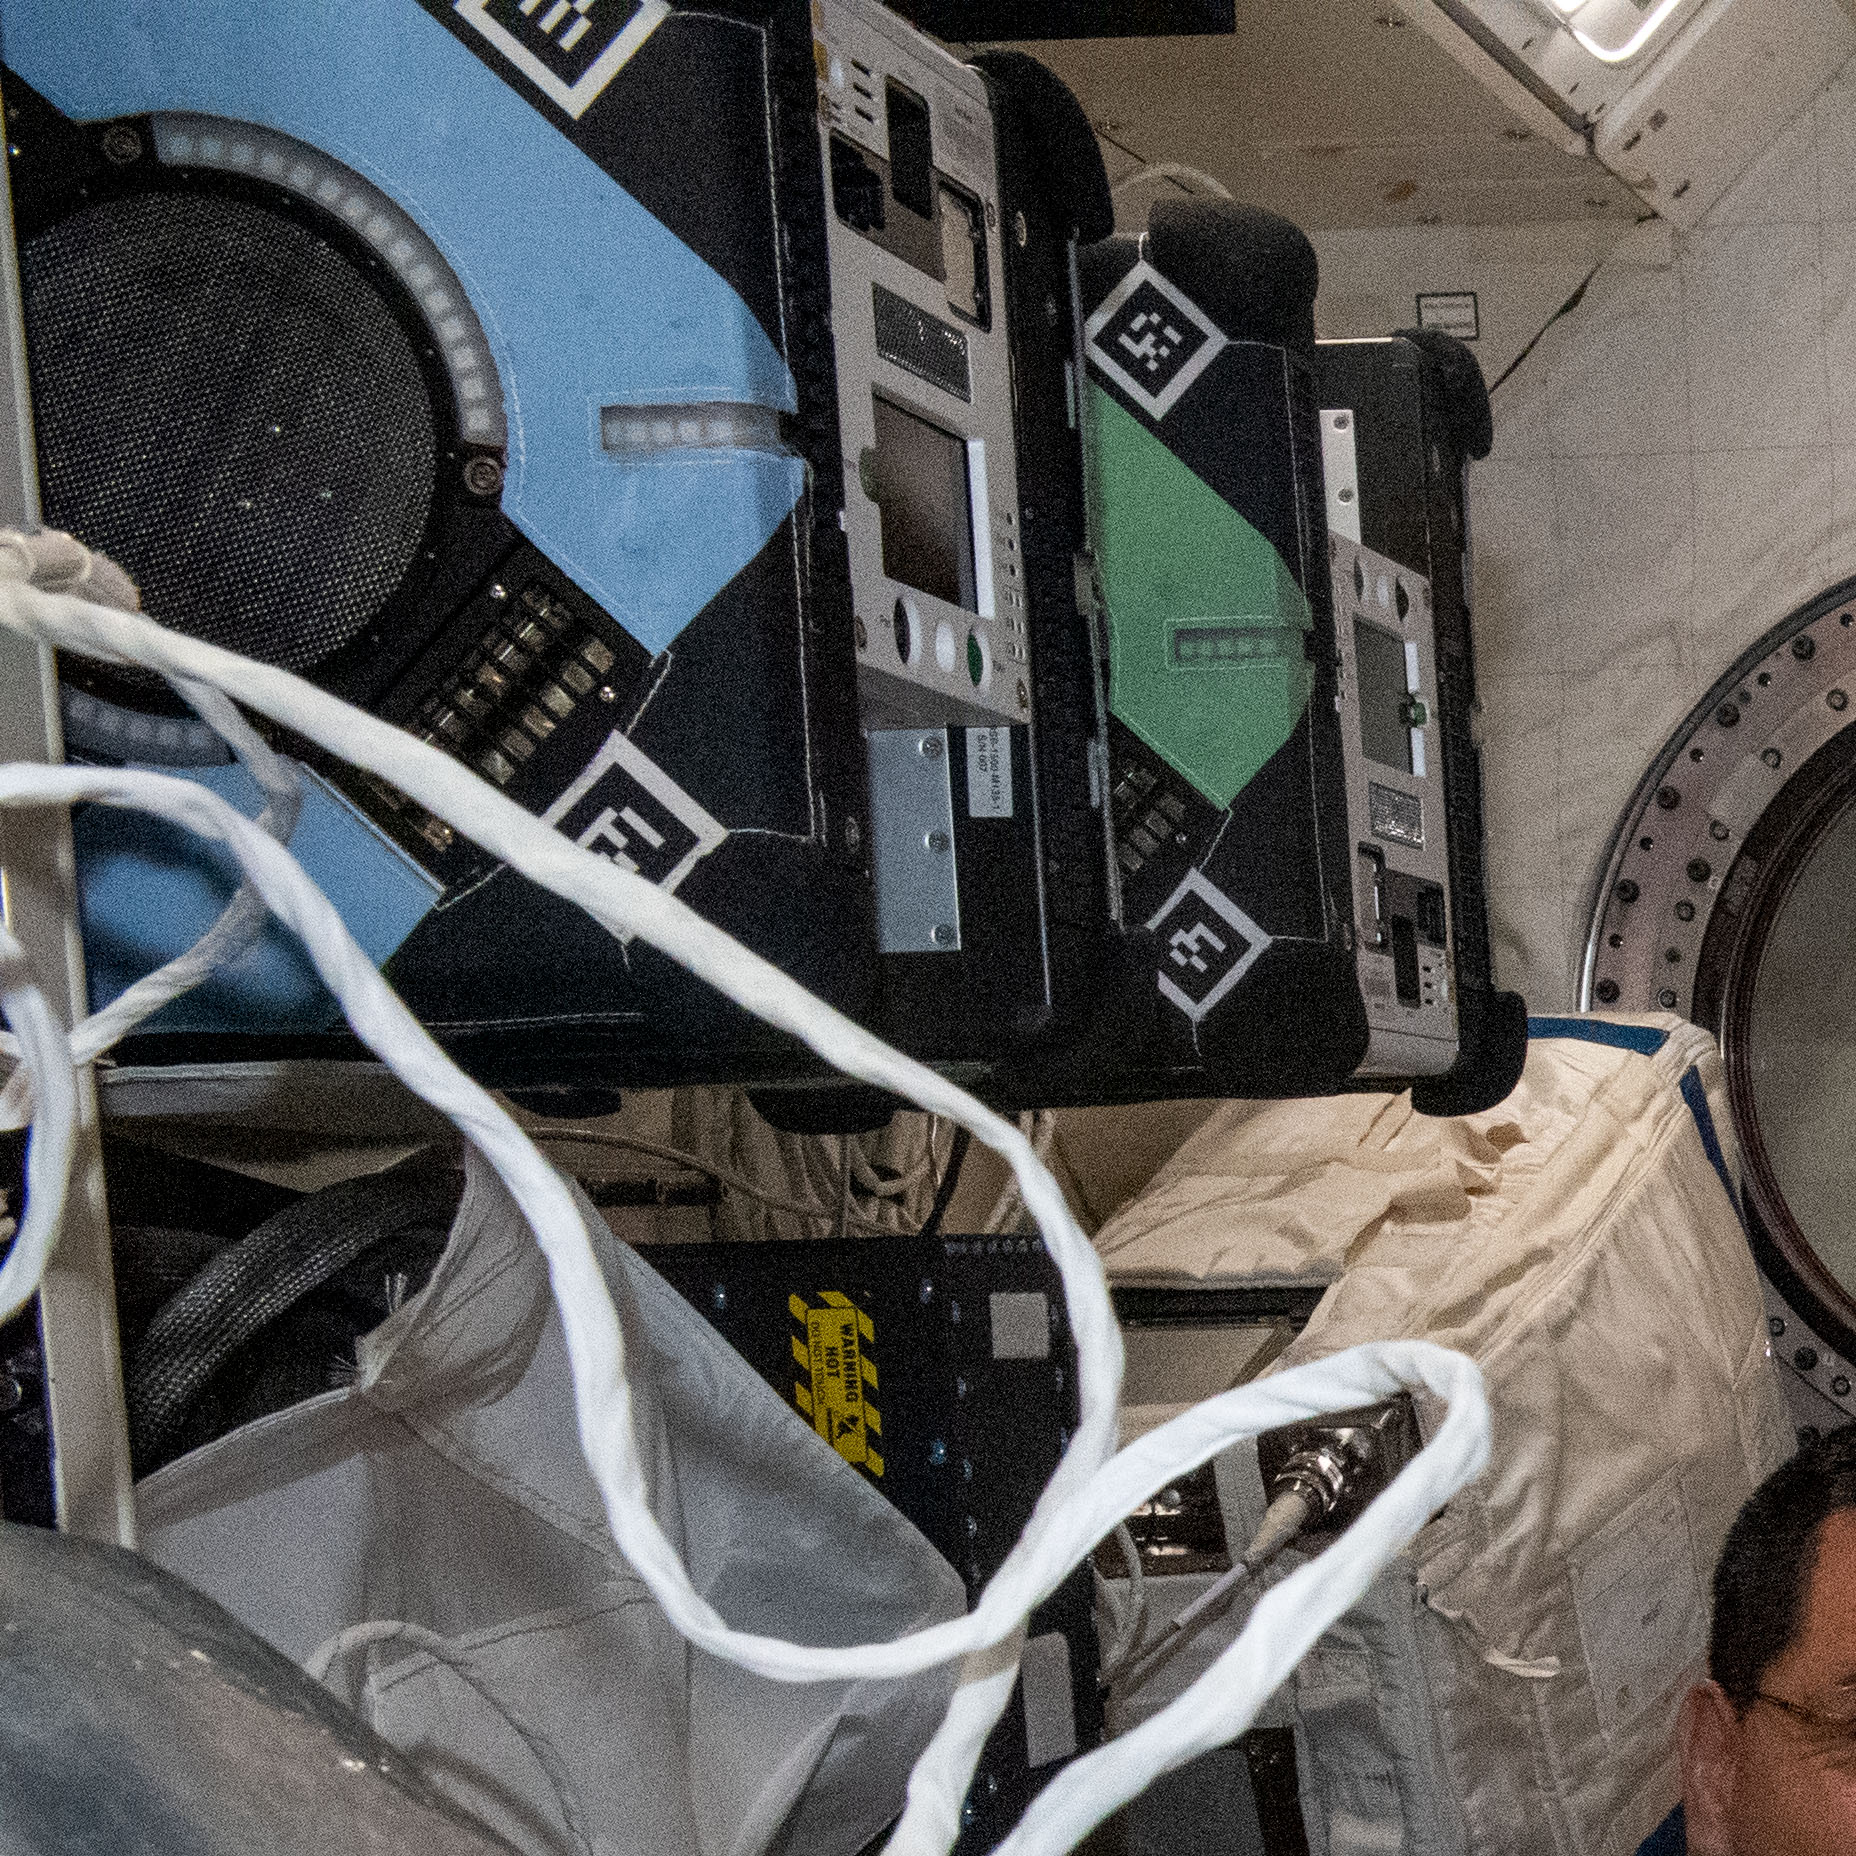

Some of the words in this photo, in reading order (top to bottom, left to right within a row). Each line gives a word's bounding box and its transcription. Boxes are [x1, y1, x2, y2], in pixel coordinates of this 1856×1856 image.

[813, 1341, 823, 1363] NOT
[826, 1347, 840, 1378] HOT
[840, 1323, 858, 1403] WARNING
